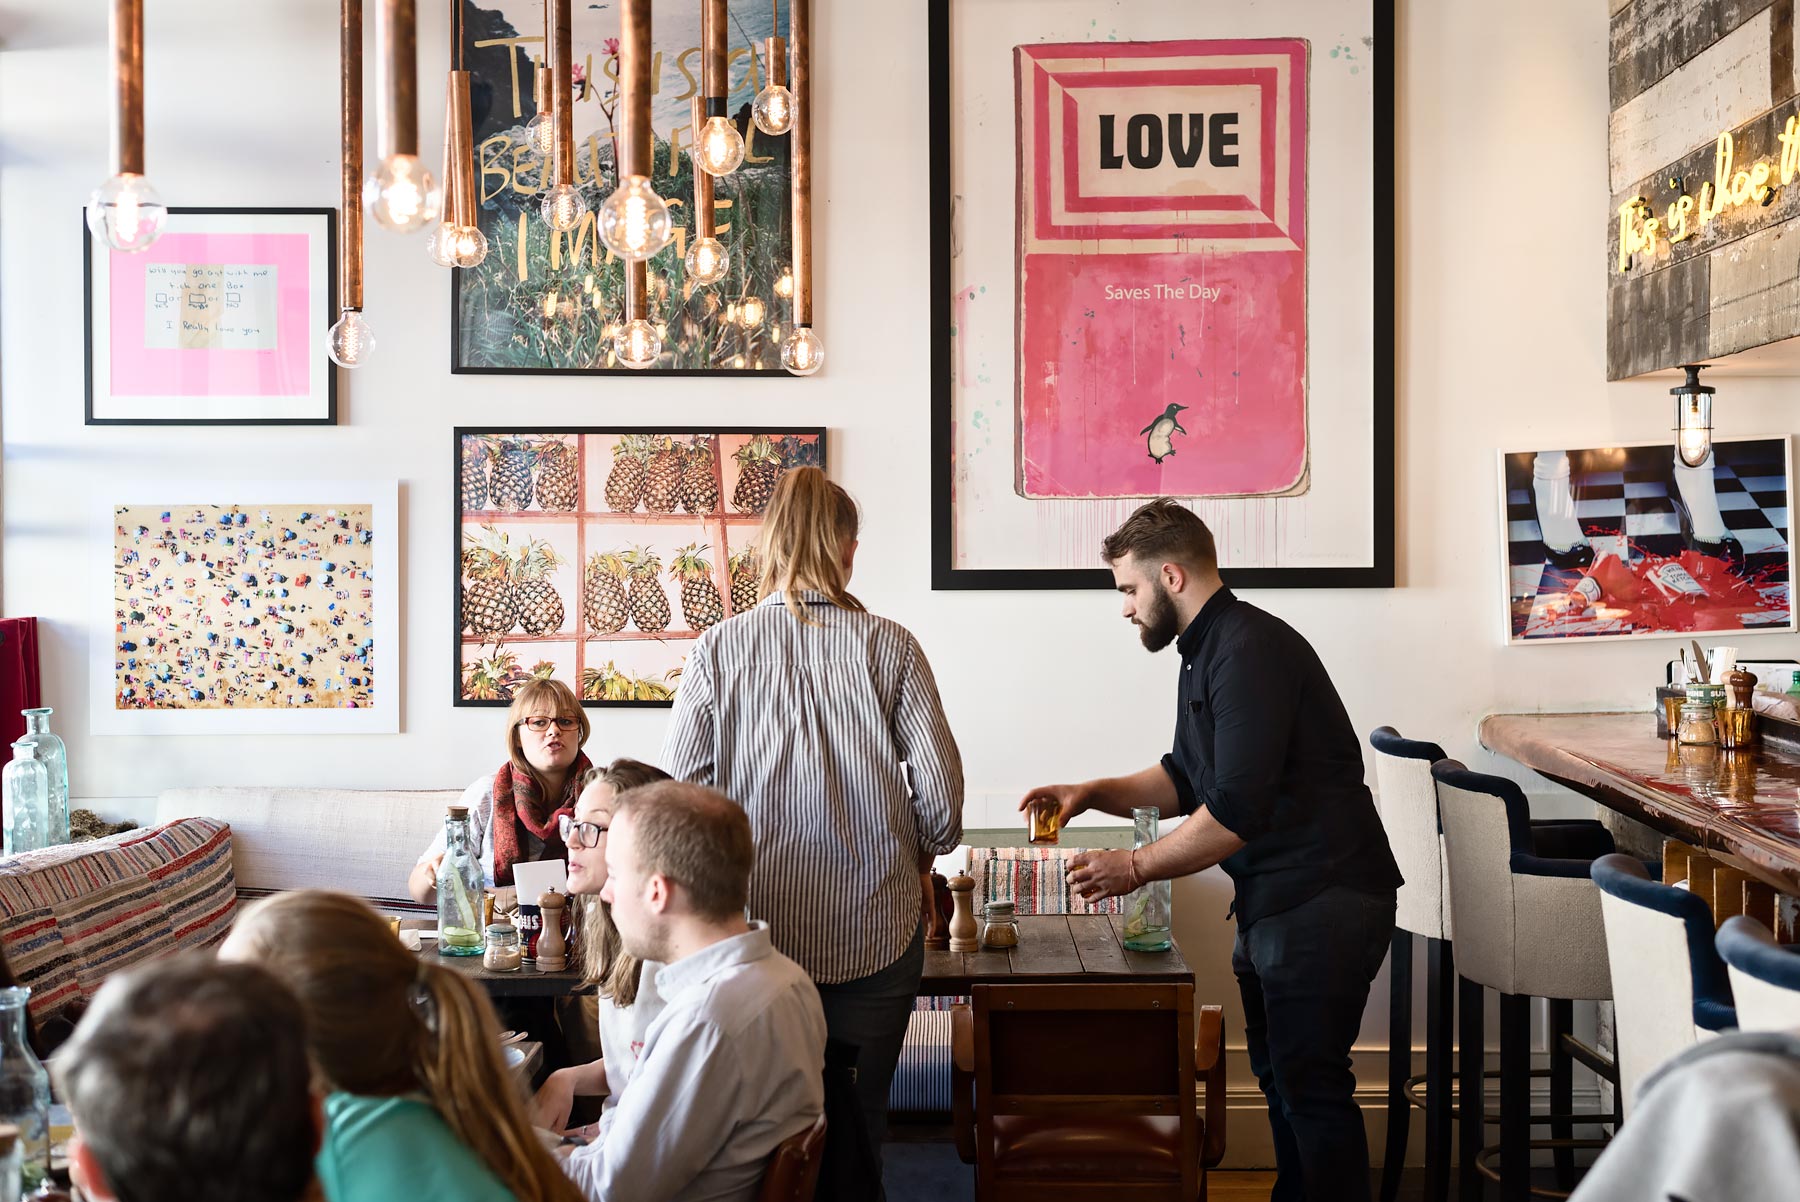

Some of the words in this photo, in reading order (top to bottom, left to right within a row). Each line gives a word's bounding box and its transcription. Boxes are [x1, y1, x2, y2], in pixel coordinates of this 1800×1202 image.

[480, 116, 776, 205] BEUFL
[1098, 112, 1239, 170] LOVE
[517, 198, 733, 282] IMG
[1618, 196, 1659, 273] This
[1667, 178, 1693, 244] is
[193, 268, 203, 278] go
[198, 282, 217, 290] one
[1105, 284, 1151, 300] Saves
[1153, 283, 1185, 300] The
[1189, 283, 1221, 303] Day
